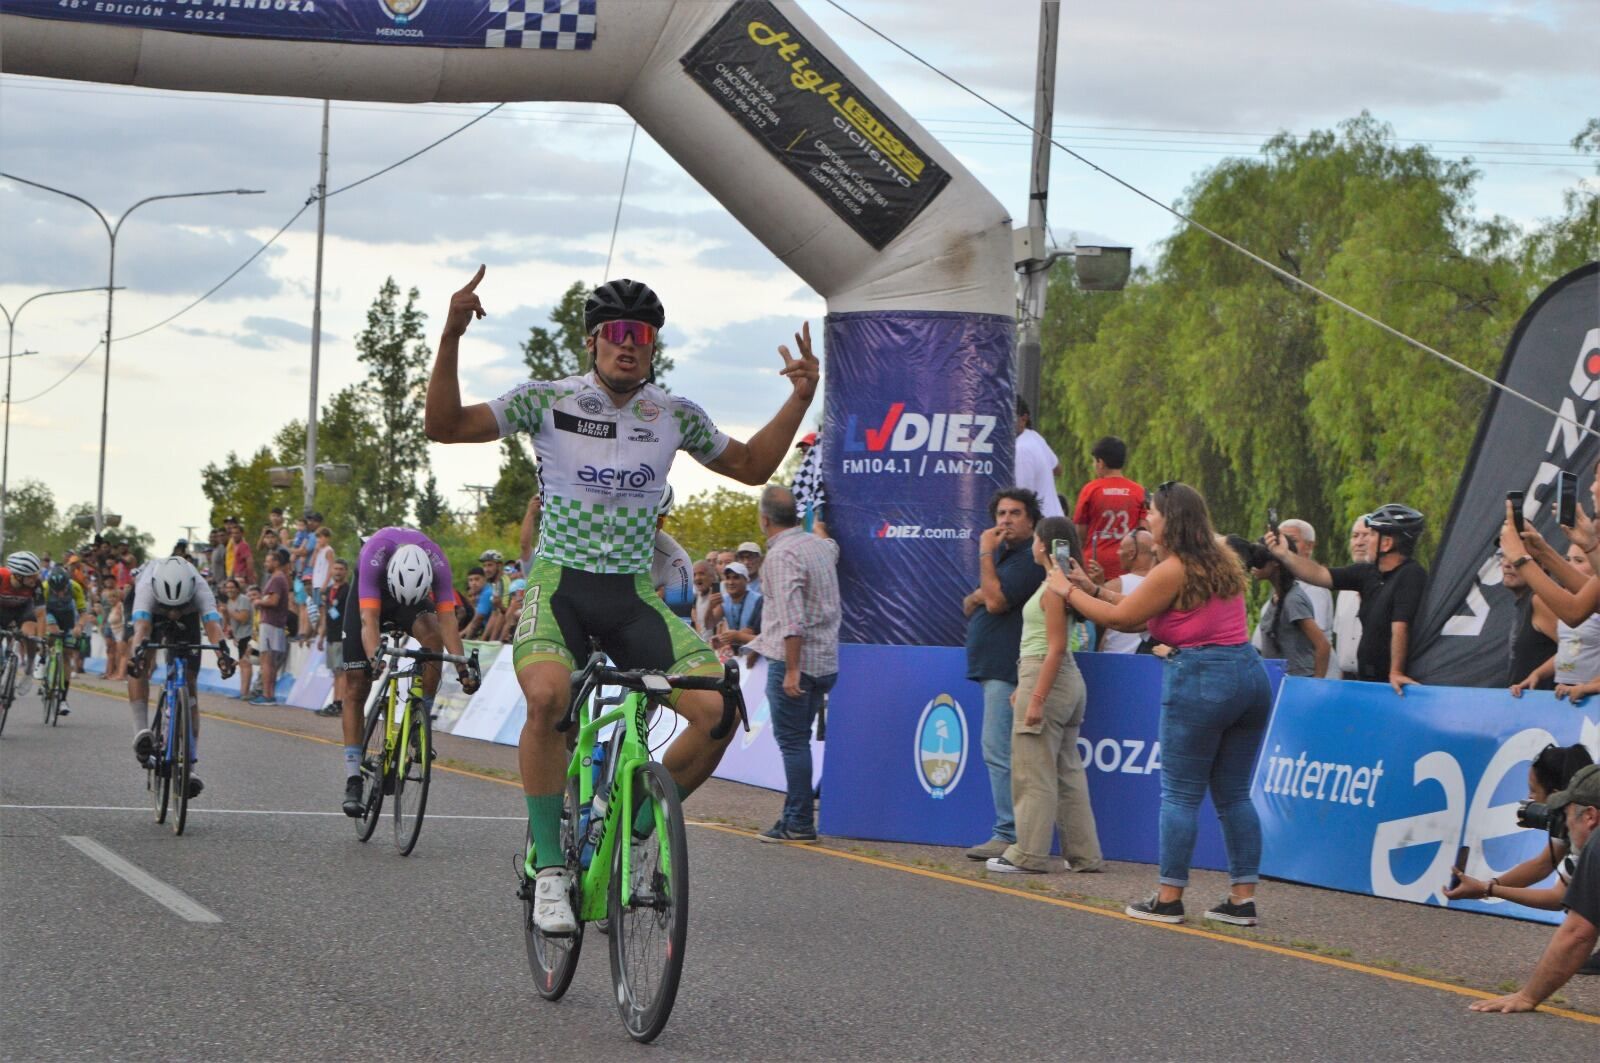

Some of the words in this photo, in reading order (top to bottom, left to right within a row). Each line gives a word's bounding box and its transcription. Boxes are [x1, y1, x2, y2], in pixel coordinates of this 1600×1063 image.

[95, 2, 164, 17] EDICIÓN
[184, 9, 225, 20] 2024
[375, 27, 425, 37] MENDOZA
[736, 65, 760, 89] ITALIA
[715, 63, 751, 96] CHACRAS
[747, 92, 760, 106] DE
[757, 102, 780, 126] CORIA
[833, 116, 911, 187] ciclismo
[576, 427, 609, 437] SPRINT
[577, 420, 610, 432] LIDER
[577, 464, 651, 489] aero
[842, 458, 911, 474] FM104.1
[934, 459, 993, 475] AM720
[1101, 509, 1130, 540] 23
[1263, 745, 1384, 808] internet
